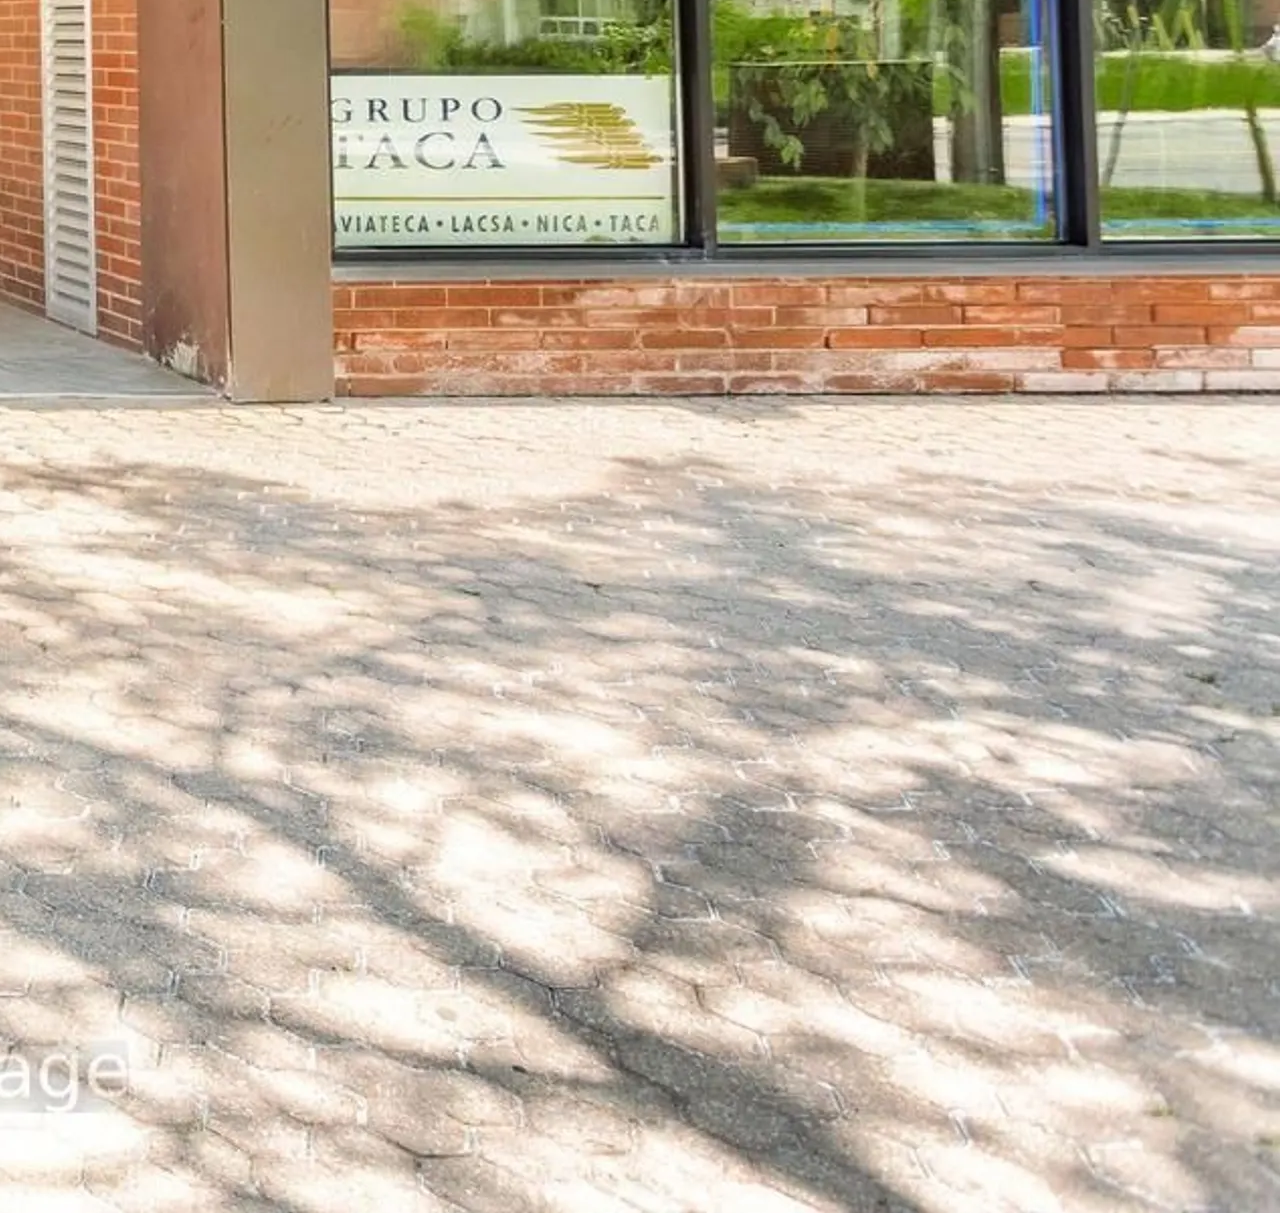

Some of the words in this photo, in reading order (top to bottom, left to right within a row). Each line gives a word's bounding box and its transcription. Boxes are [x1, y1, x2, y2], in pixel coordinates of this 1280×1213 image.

[331, 97, 503, 123] GRUPO
[333, 214, 430, 234] VIATECA
[451, 214, 515, 234] LACSA
[537, 214, 588, 234] NICA
[609, 214, 660, 234] TACA
